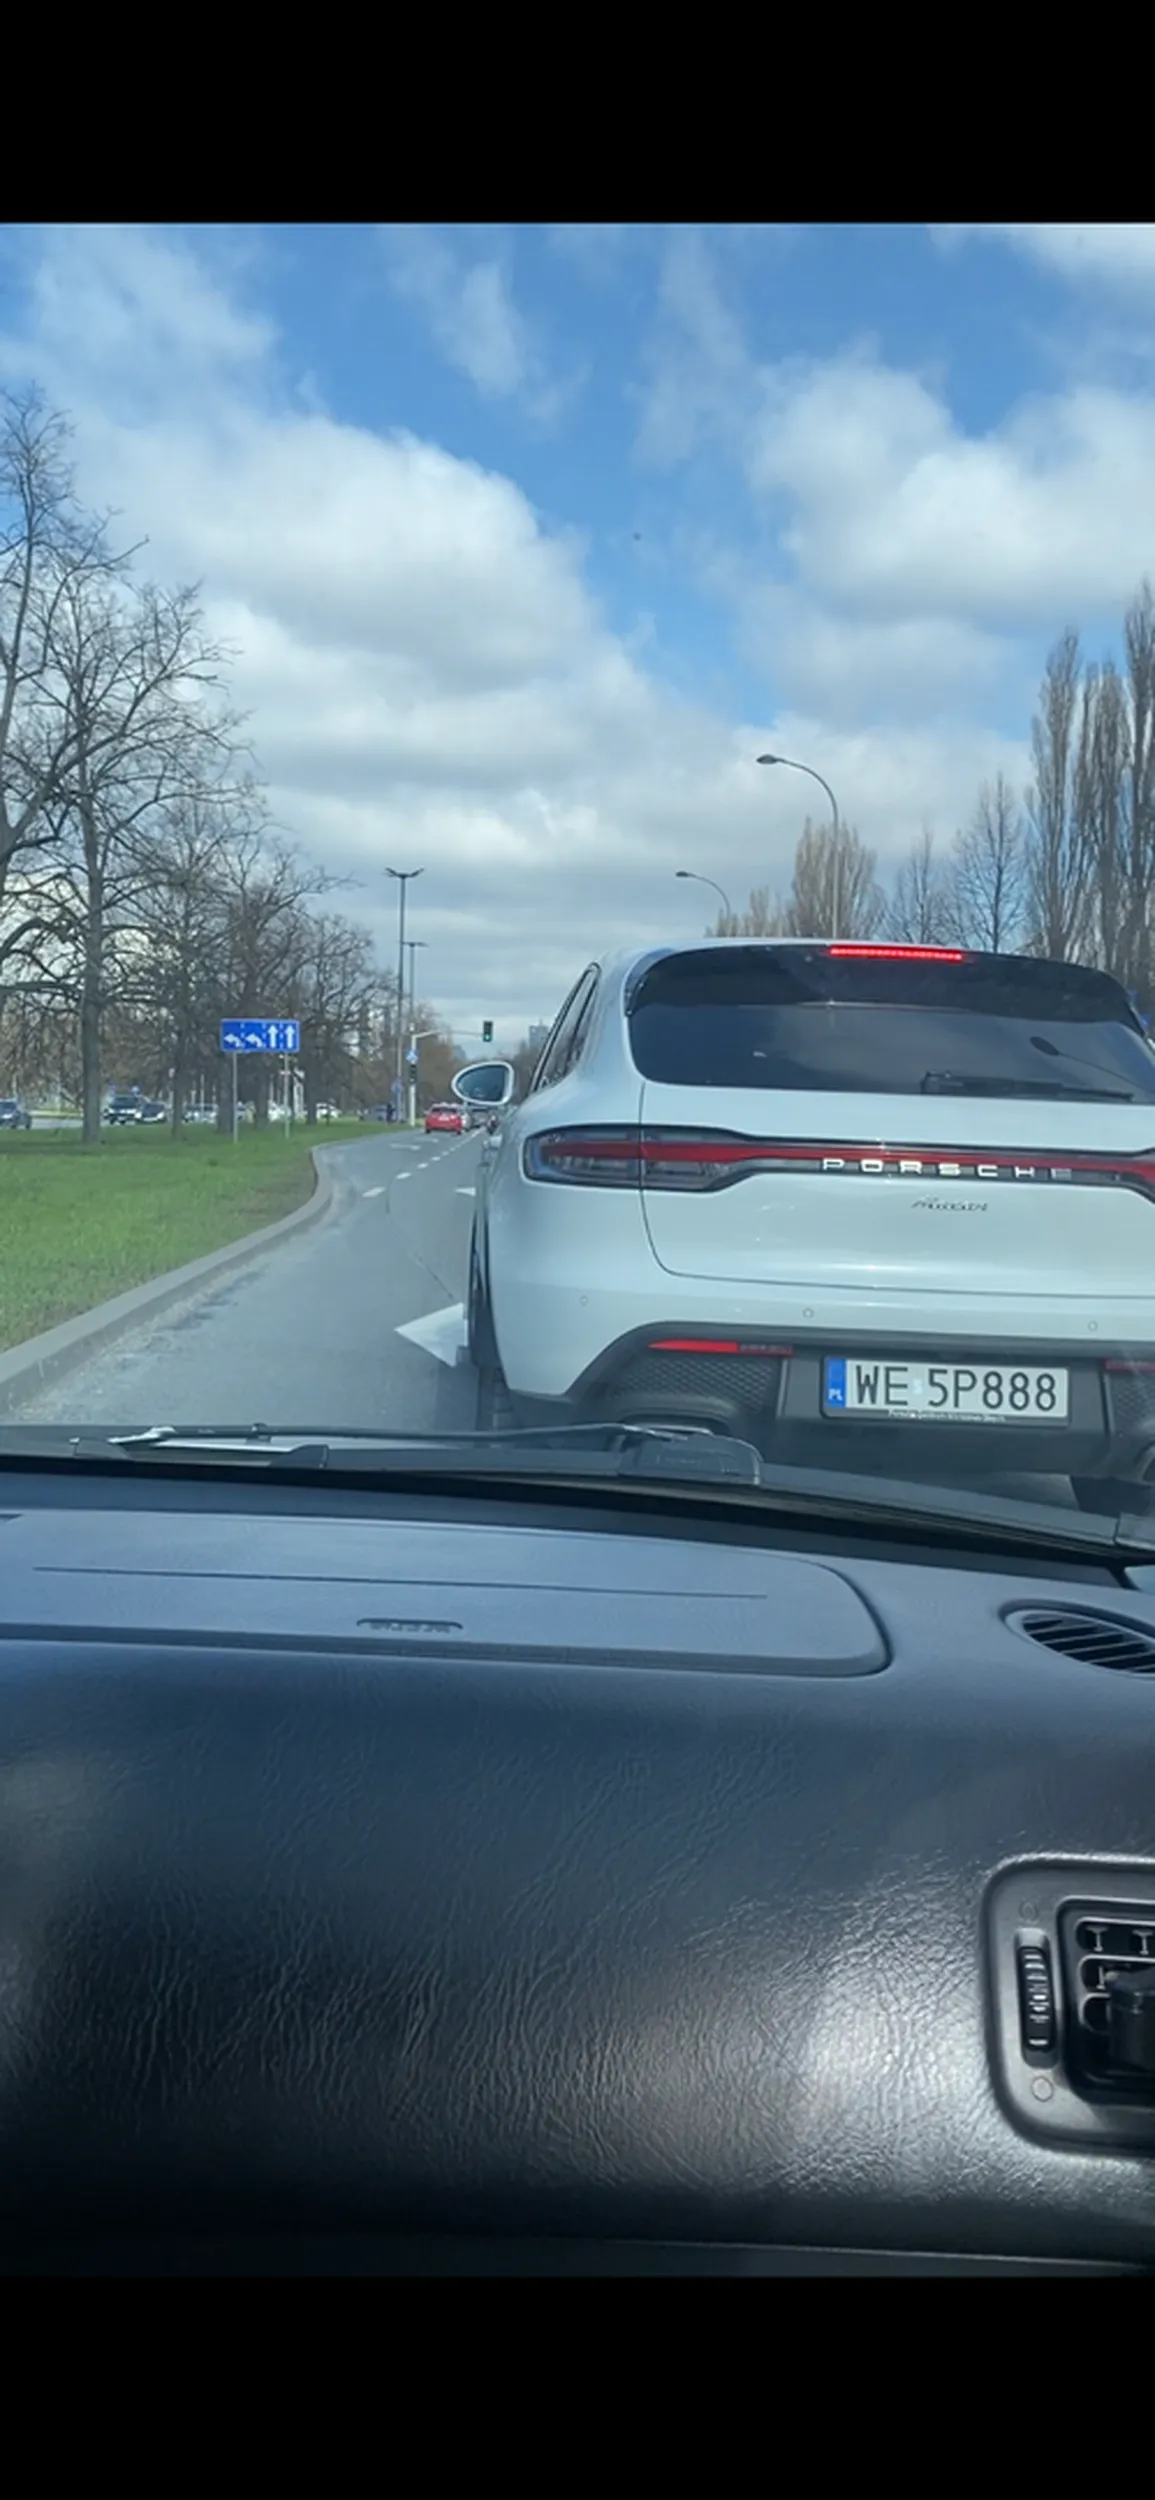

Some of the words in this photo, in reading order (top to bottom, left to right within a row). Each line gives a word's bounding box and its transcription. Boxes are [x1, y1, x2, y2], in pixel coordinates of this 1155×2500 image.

[822, 1157, 1073, 1181] PORSCHE
[855, 1364, 909, 1406] WE
[927, 1367, 1057, 1412] 5P888
